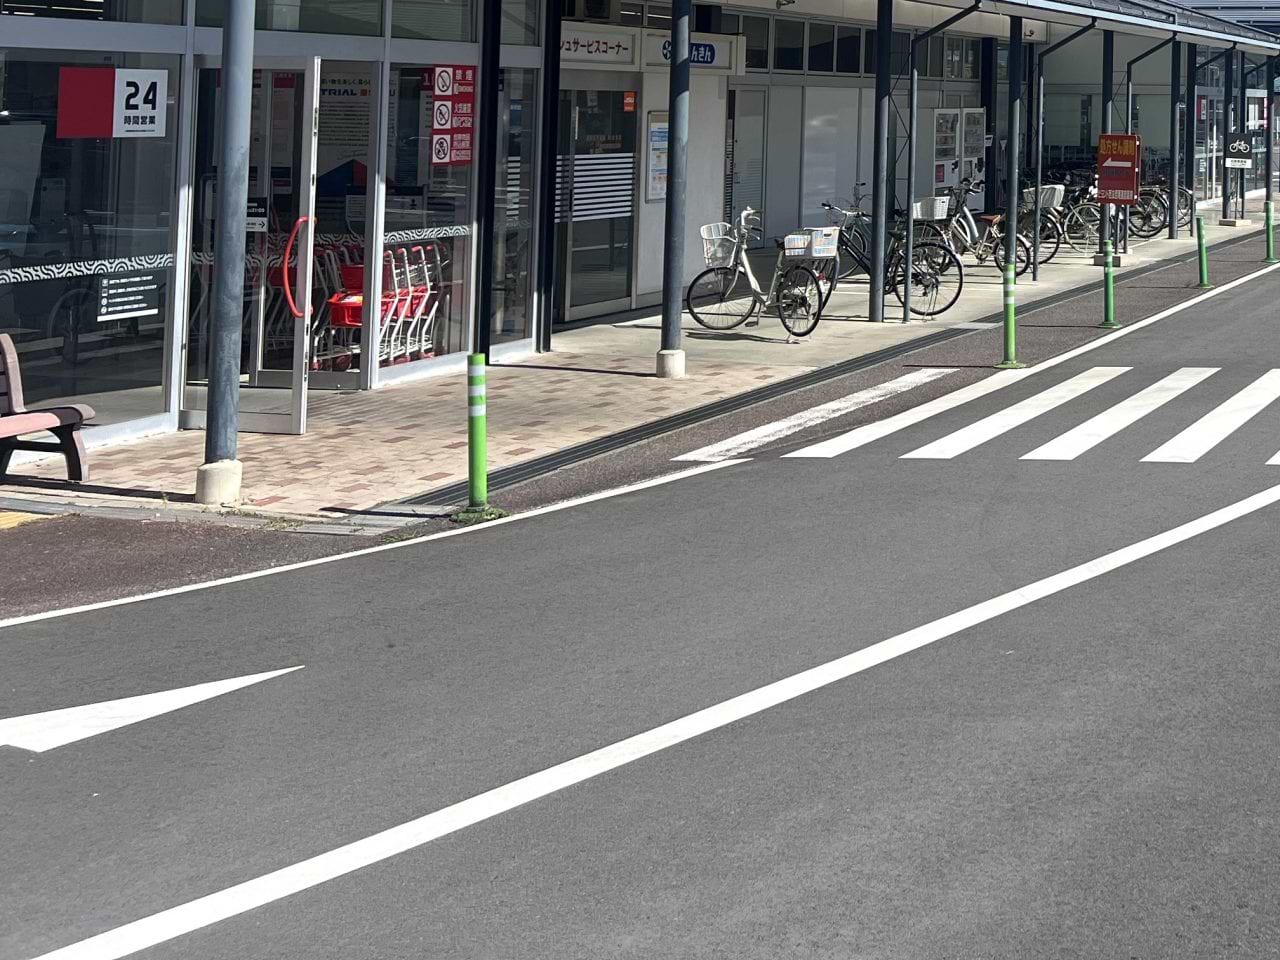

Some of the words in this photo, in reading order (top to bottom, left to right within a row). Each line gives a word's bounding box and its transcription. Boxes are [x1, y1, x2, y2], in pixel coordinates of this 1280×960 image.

[690, 44, 711, 62] んきん
[125, 81, 157, 110] 24
[124, 115, 156, 125] 時間営業
